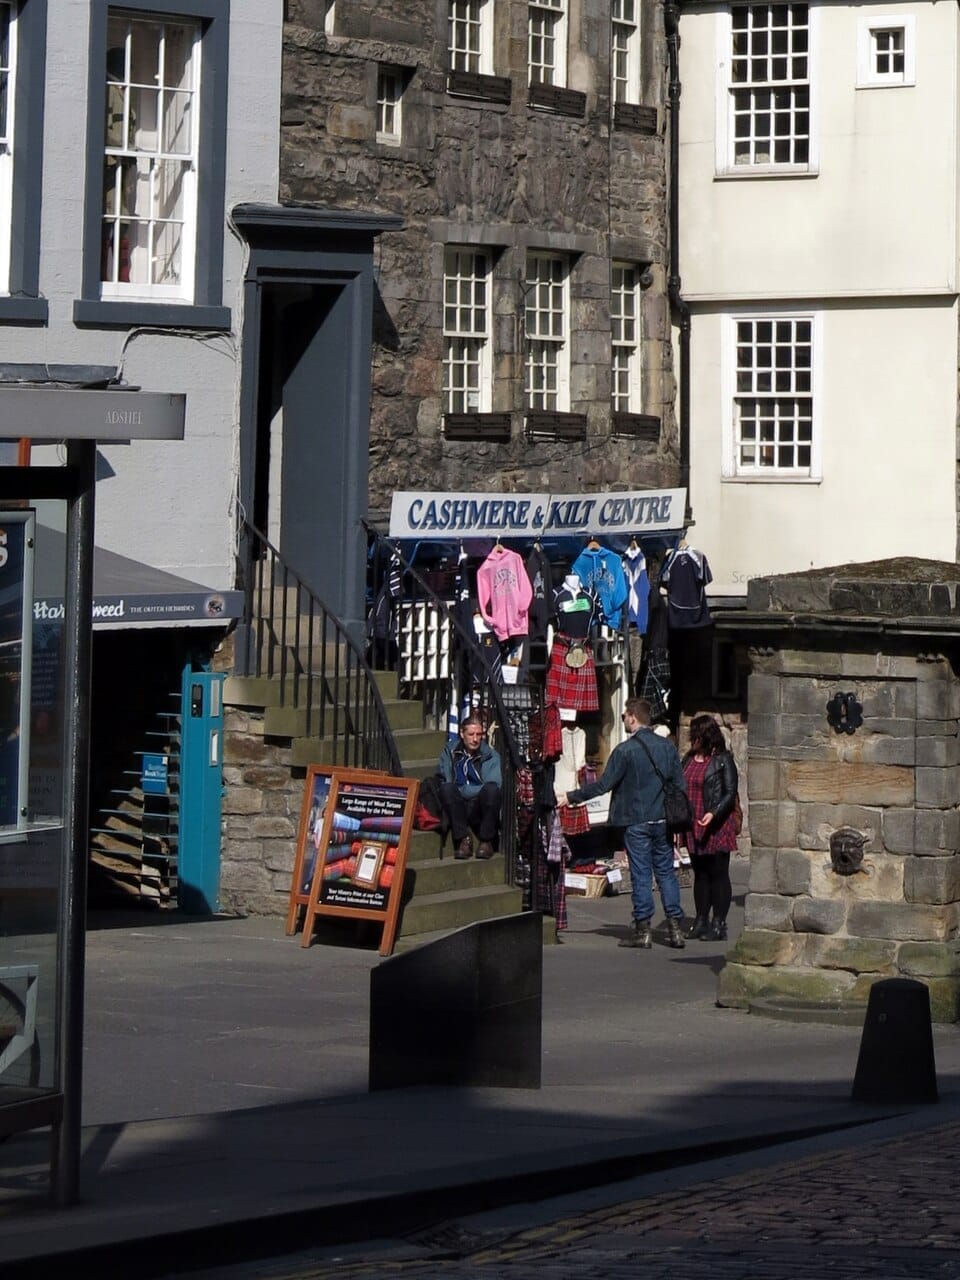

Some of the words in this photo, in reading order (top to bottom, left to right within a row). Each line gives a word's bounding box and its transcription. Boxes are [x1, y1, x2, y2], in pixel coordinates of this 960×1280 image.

[407, 499, 532, 530] CASHMERE
[531, 505, 545, 529] &
[548, 500, 597, 529] KILT
[599, 495, 673, 527] CENTRE
[34, 601, 65, 619] Har
[92, 600, 124, 617] weed
